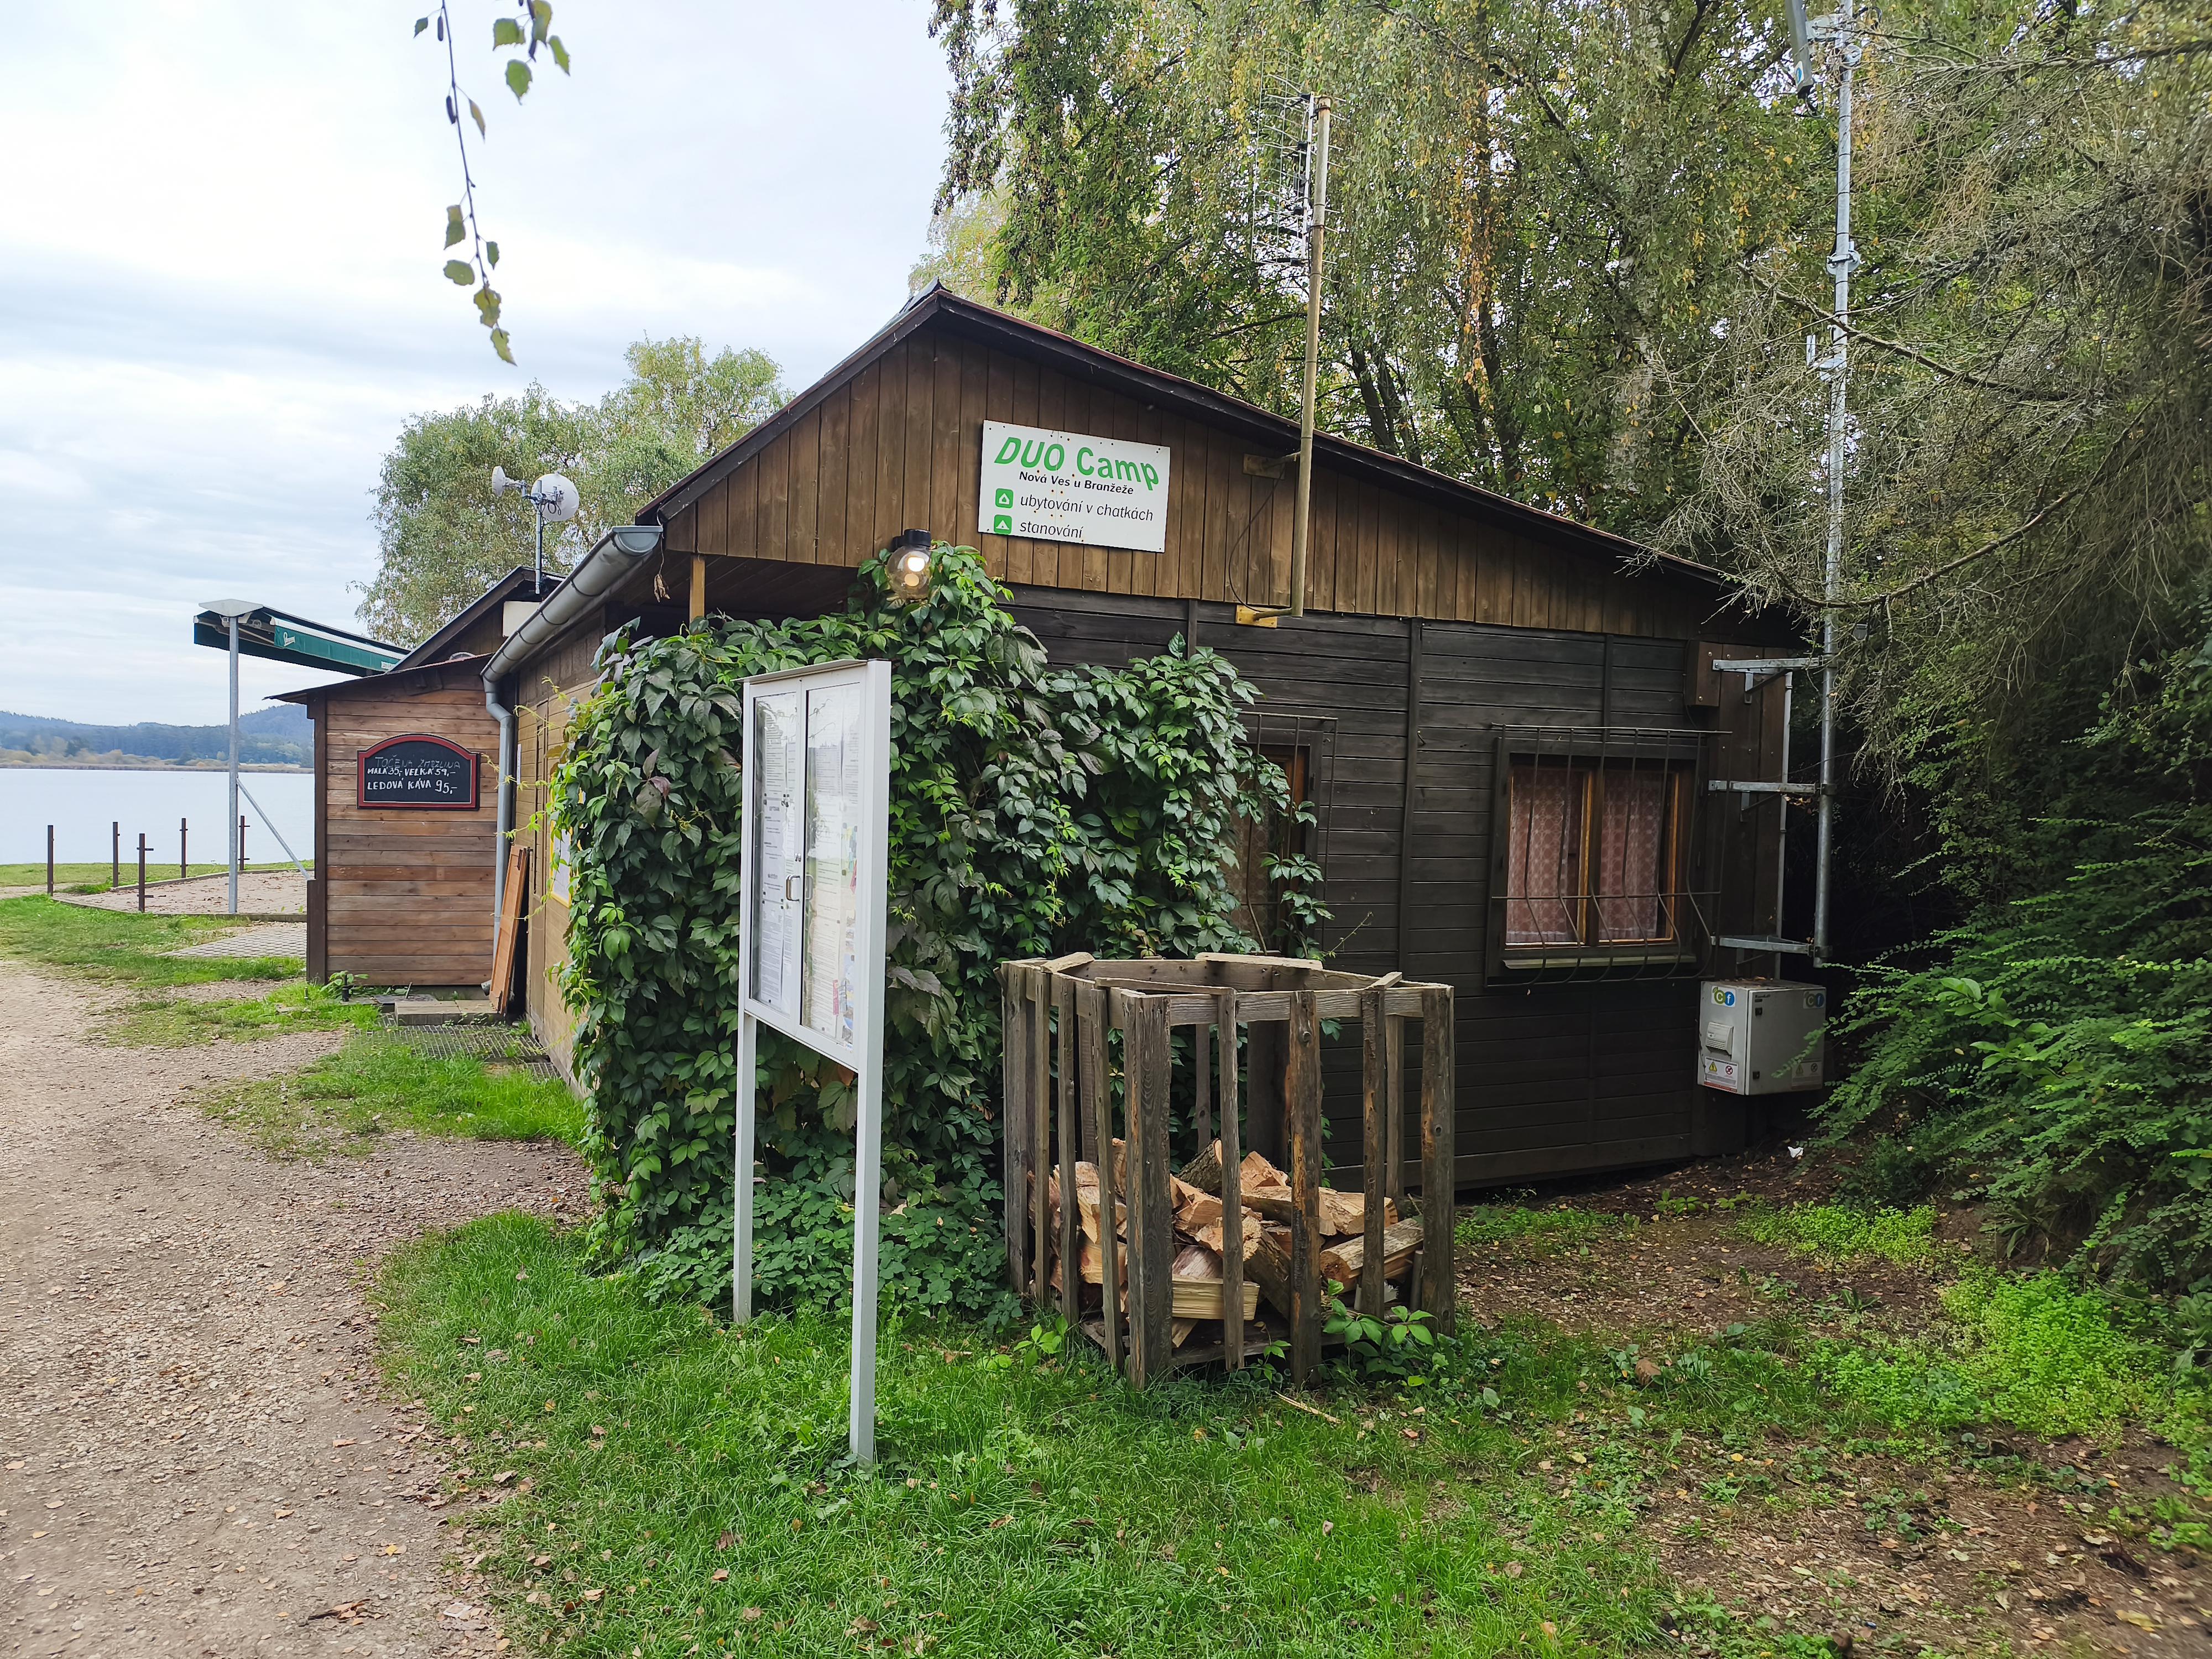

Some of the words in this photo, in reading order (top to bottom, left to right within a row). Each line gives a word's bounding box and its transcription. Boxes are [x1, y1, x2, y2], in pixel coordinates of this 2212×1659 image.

[994, 437, 1065, 471] DUO
[1077, 447, 1159, 491] Camp
[1019, 471, 1047, 484] Nová
[1051, 476, 1070, 487] Ves
[1084, 480, 1134, 494] Branžeže
[1020, 494, 1082, 513] ubytování
[1087, 504, 1093, 514] v
[1097, 504, 1153, 521] chatkách
[1019, 521, 1082, 539] stanování
[404, 768, 434, 776] VELKÁ
[367, 778, 404, 790] LEDOVÁ
[408, 778, 431, 790] KÁVA
